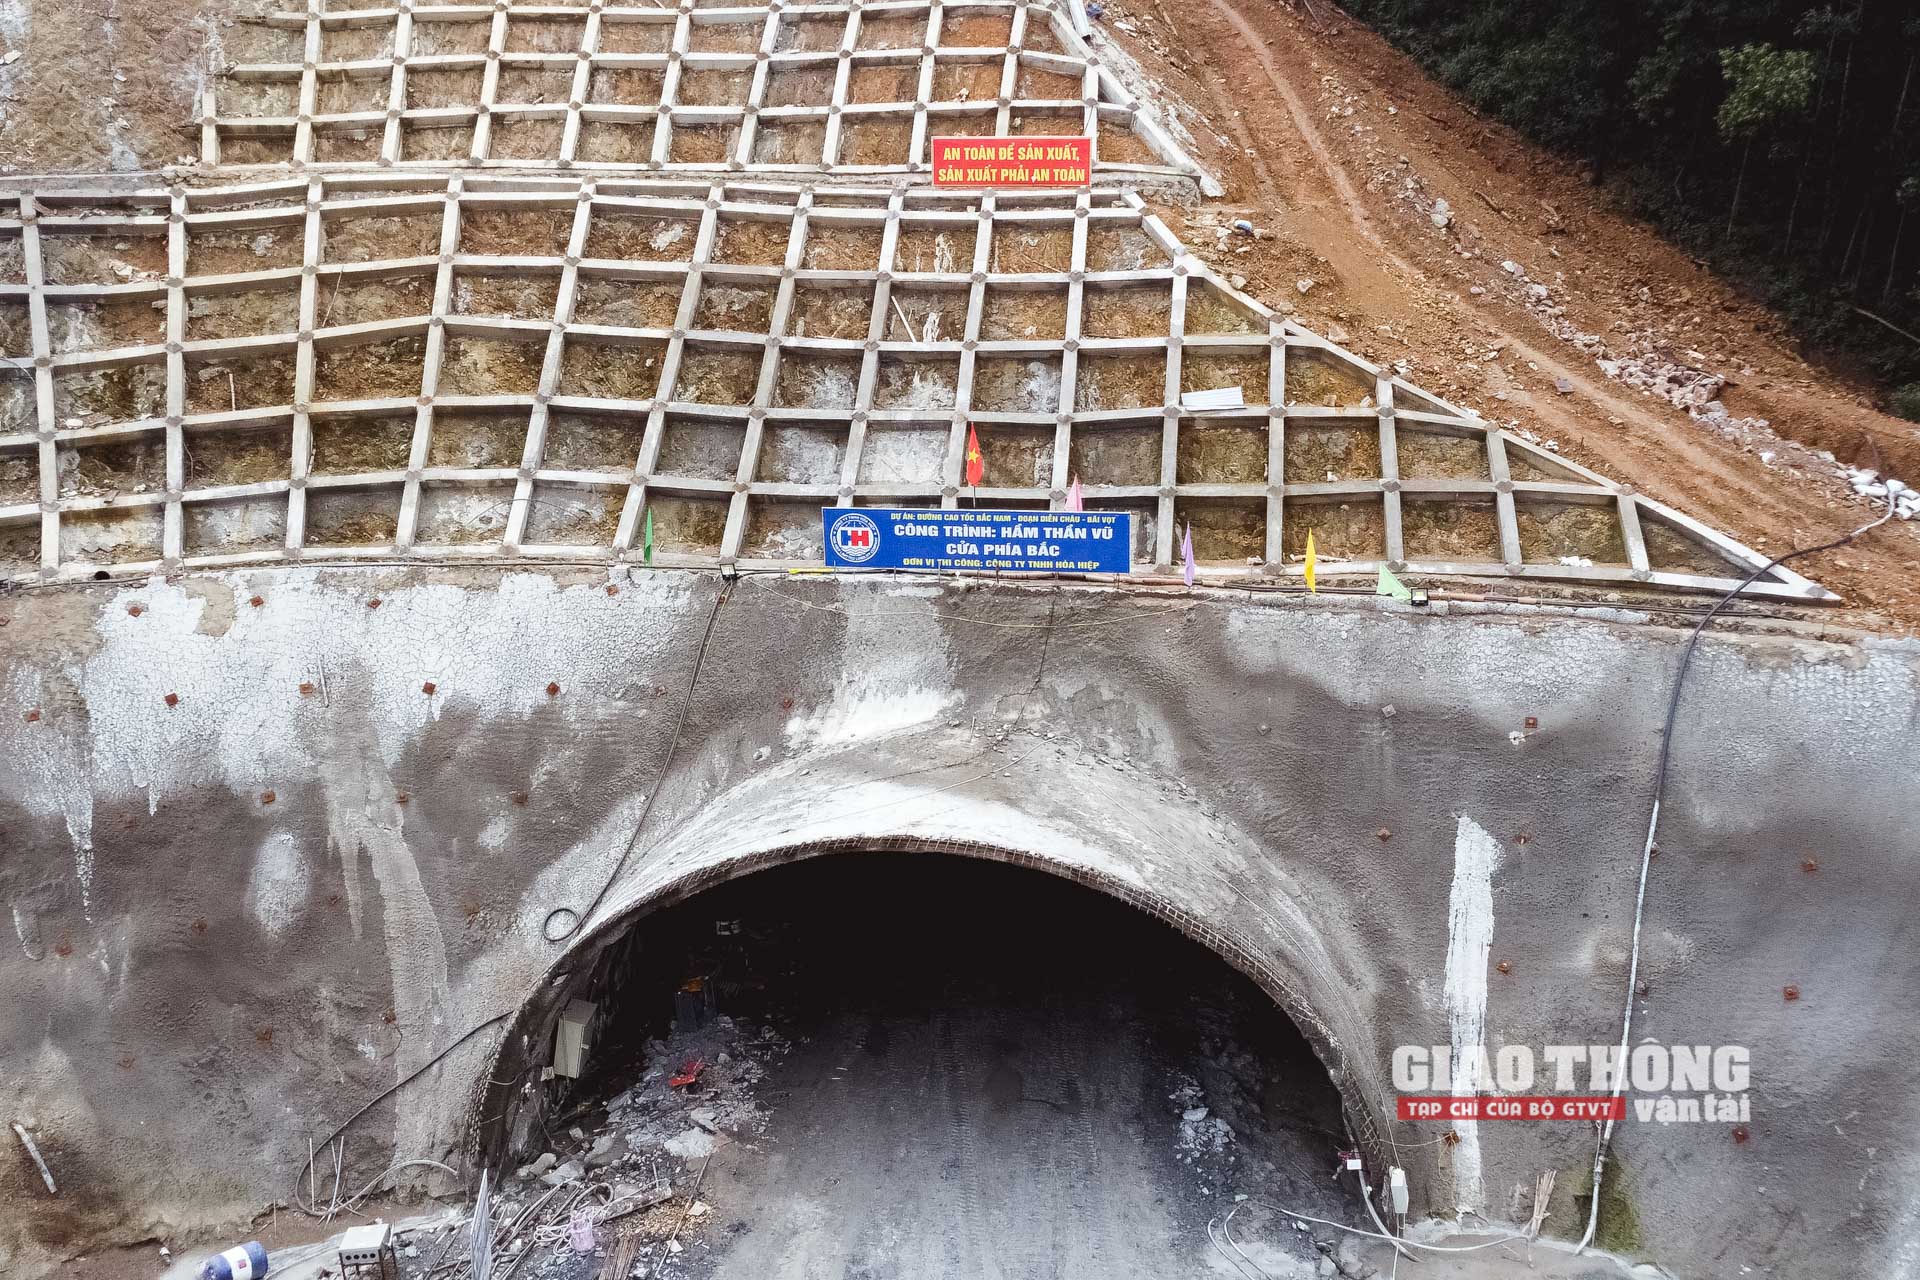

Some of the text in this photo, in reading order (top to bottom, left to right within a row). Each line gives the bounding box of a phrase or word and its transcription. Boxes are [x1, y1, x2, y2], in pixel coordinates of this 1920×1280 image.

[944, 142, 1080, 162] AN TOÀN ĐỂ SẢN XUẤT,
[938, 164, 1085, 182] SẢN XUẤT PHẢI AN TOÀN
[903, 512, 915, 520] ÁN:
[944, 513, 959, 521] CAO
[961, 513, 974, 521] TỐC
[993, 514, 1011, 522] NAM
[1102, 516, 1116, 524] VỌT
[894, 523, 939, 536] CÔNG
[943, 524, 996, 538] TRÌNH:
[1091, 526, 1113, 540] VŨ
[946, 541, 1060, 556] CỬA PHÍA BẮC
[903, 558, 922, 566] ĐƠN
[925, 558, 934, 567] VỊ
[937, 558, 952, 566] THI
[954, 558, 983, 567] CÔNG:
[986, 559, 1011, 568] CÔNG
[1056, 560, 1075, 569] HÒA
[1078, 561, 1100, 570] HIỆP
